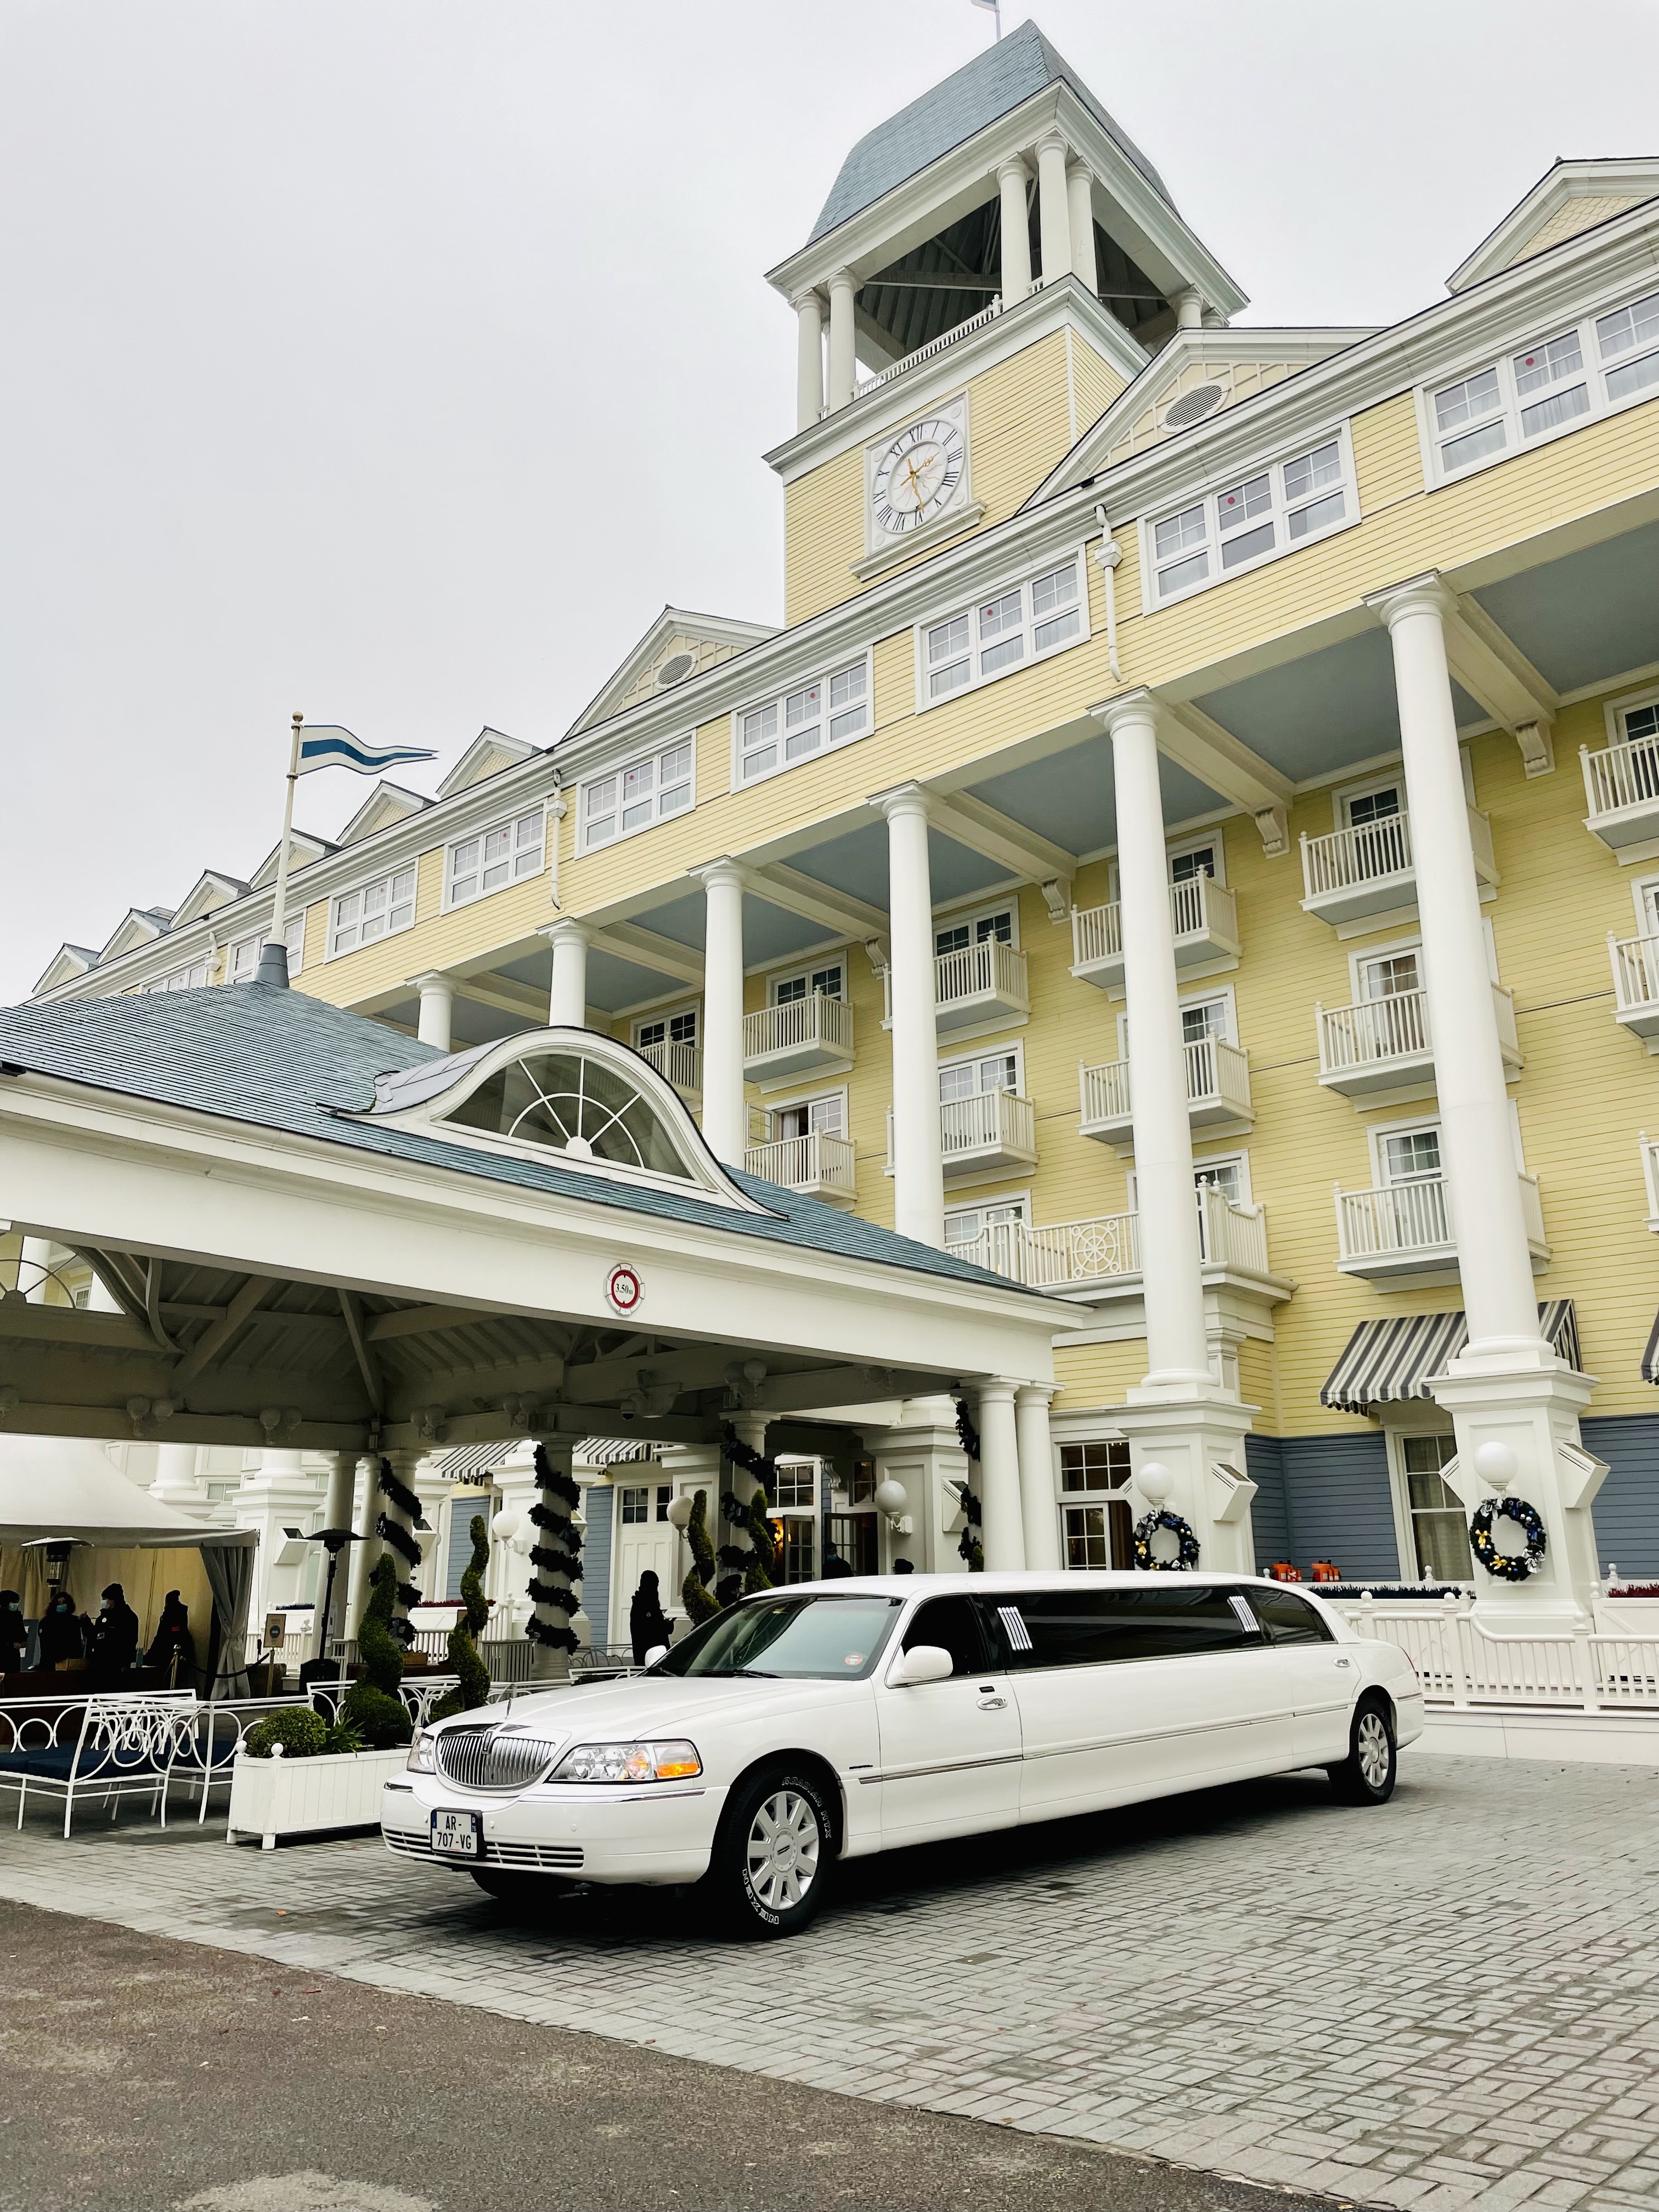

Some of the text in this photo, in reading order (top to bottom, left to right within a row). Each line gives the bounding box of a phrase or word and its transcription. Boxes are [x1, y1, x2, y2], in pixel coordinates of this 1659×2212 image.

[909, 425, 923, 443] XII
[942, 428, 958, 446] II
[890, 442, 903, 459] XI
[947, 447, 963, 463] III
[942, 471, 960, 487] IIII
[873, 489, 887, 504] IX
[934, 497, 942, 509] V
[877, 504, 893, 527] VIII
[892, 512, 905, 531] VII
[615, 1283, 629, 1294] 3.50
[782, 1776, 823, 1807] ROADIAN
[820, 1810, 832, 1838] HTX
[437, 1832, 471, 1849] 707-VG
[742, 1868, 780, 1925] NEXEN
